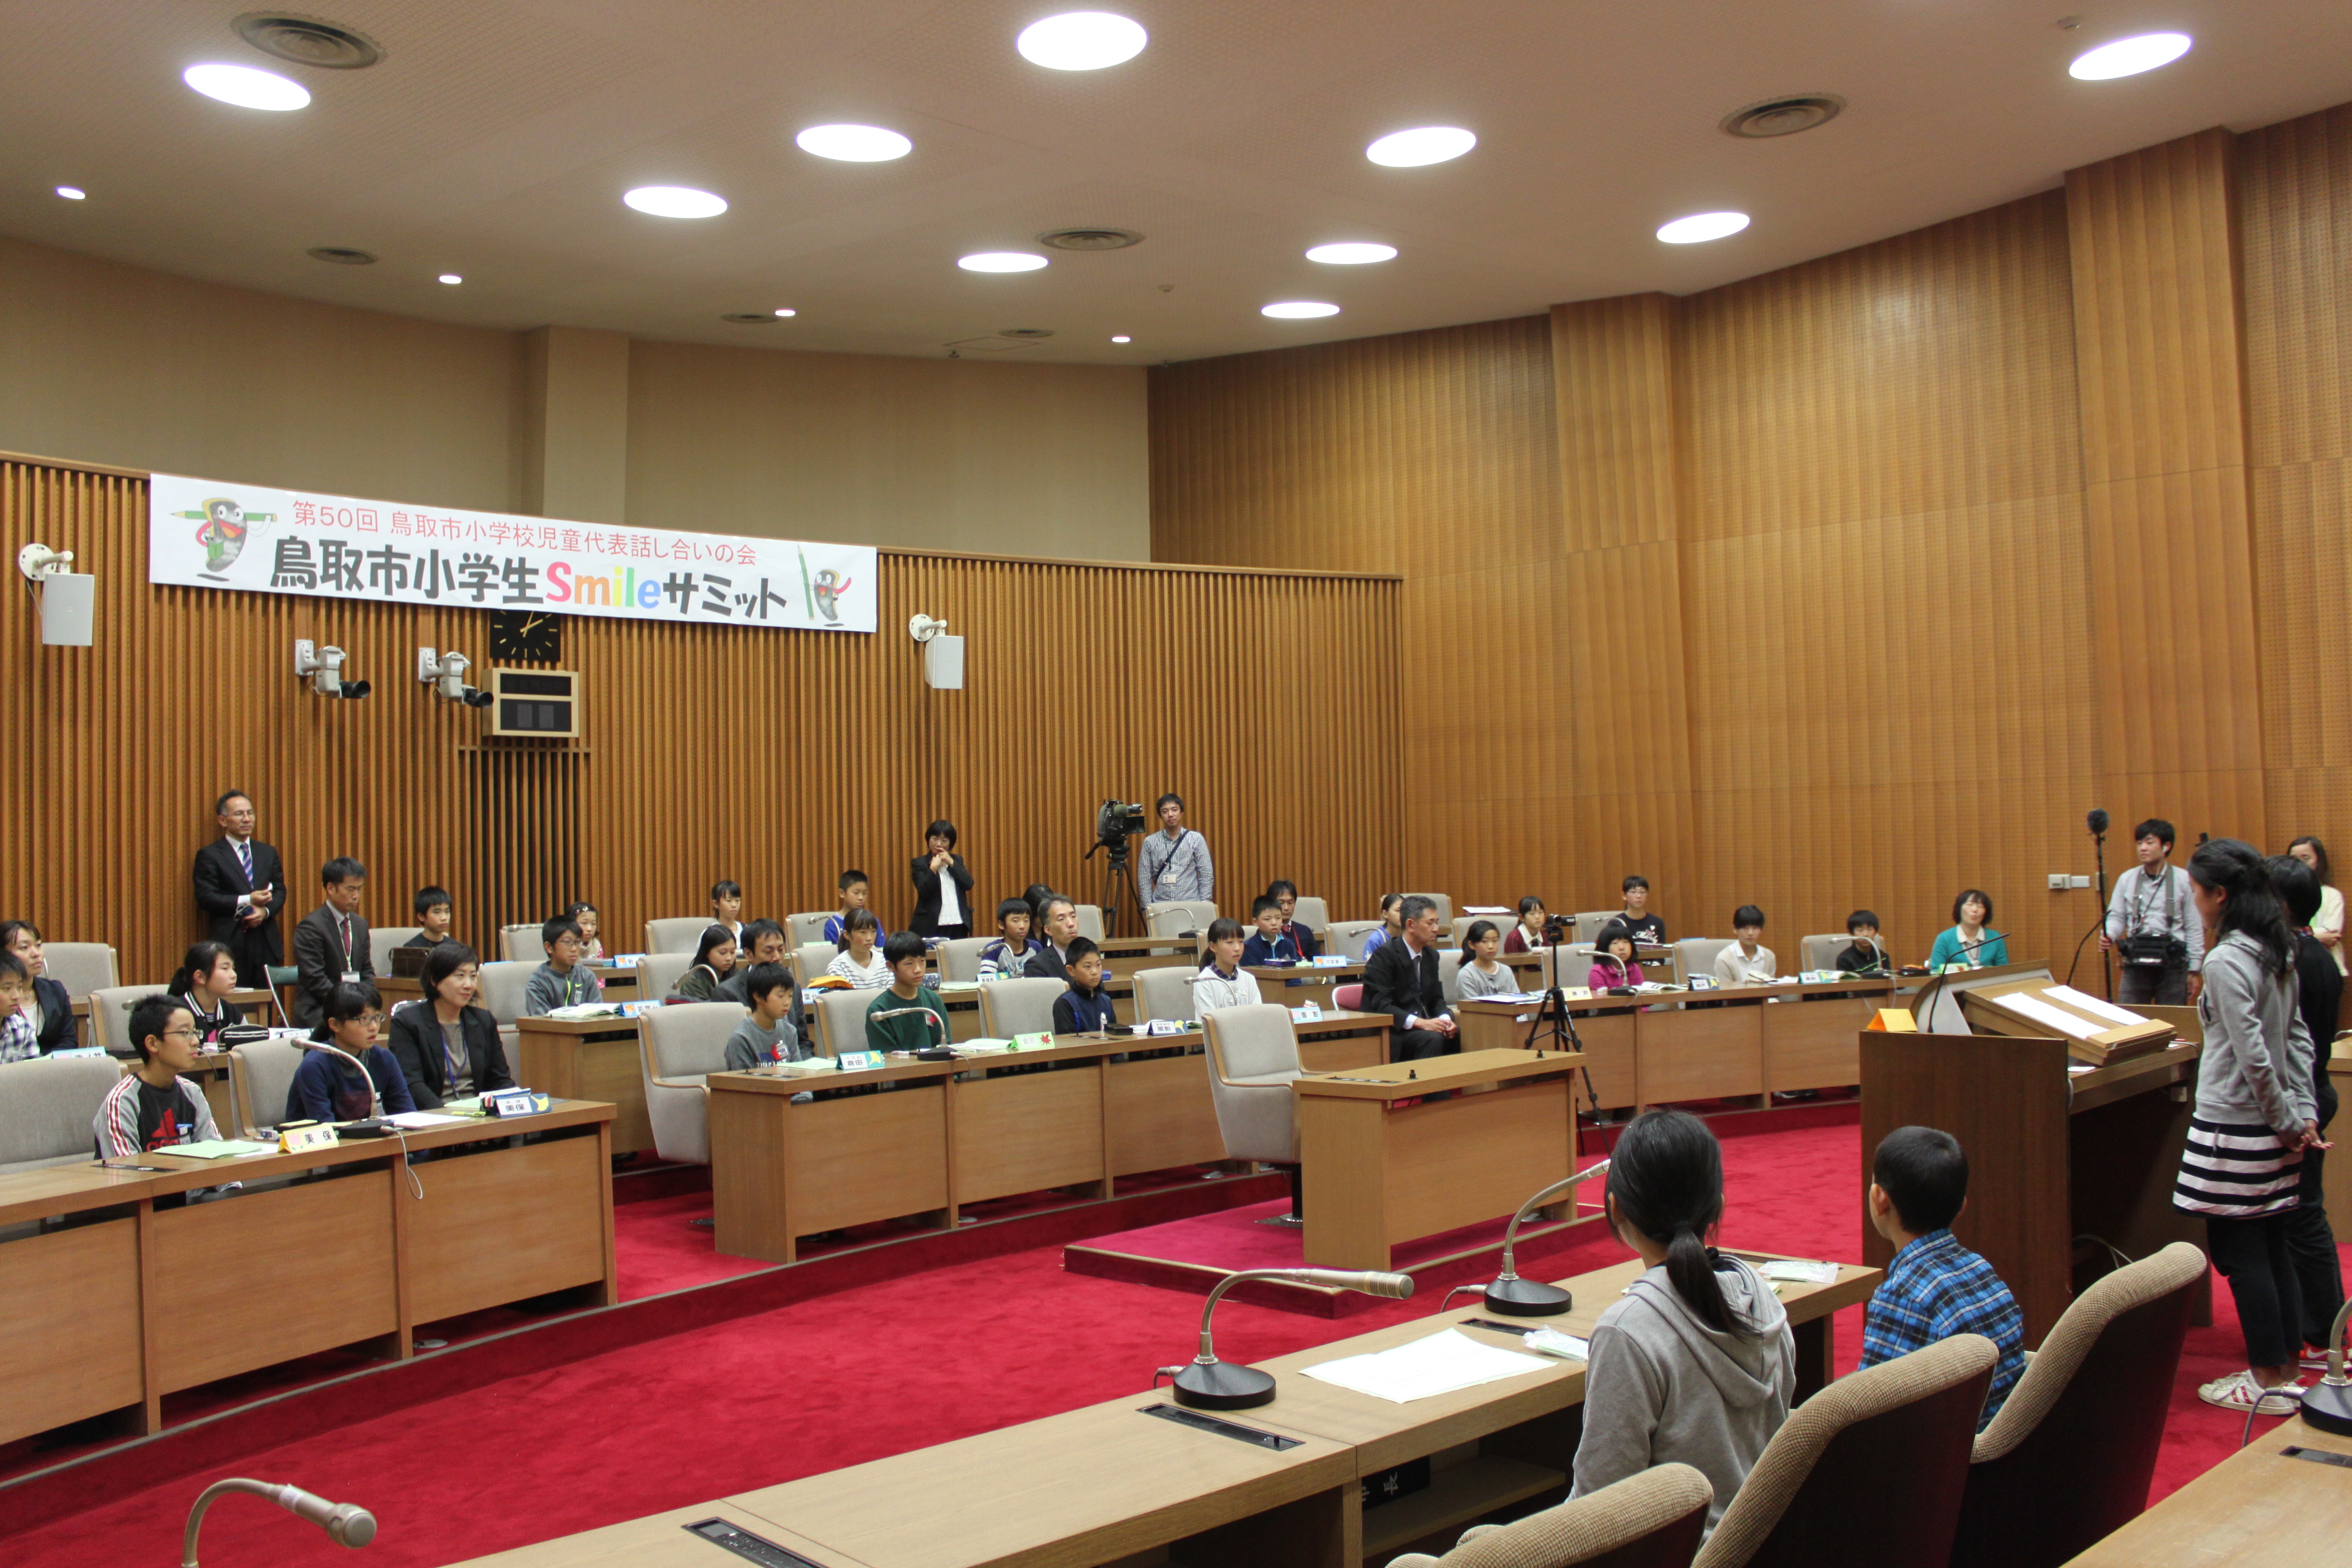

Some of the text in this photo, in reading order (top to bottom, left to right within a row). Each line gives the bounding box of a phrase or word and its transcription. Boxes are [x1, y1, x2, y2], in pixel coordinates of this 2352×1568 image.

[293, 500, 756, 565] 第50回 鳥取市小学校児童代表話し合いの会
[270, 535, 787, 620] 鳥取市小学生Smileサミット
[304, 1130, 333, 1144] 美保
